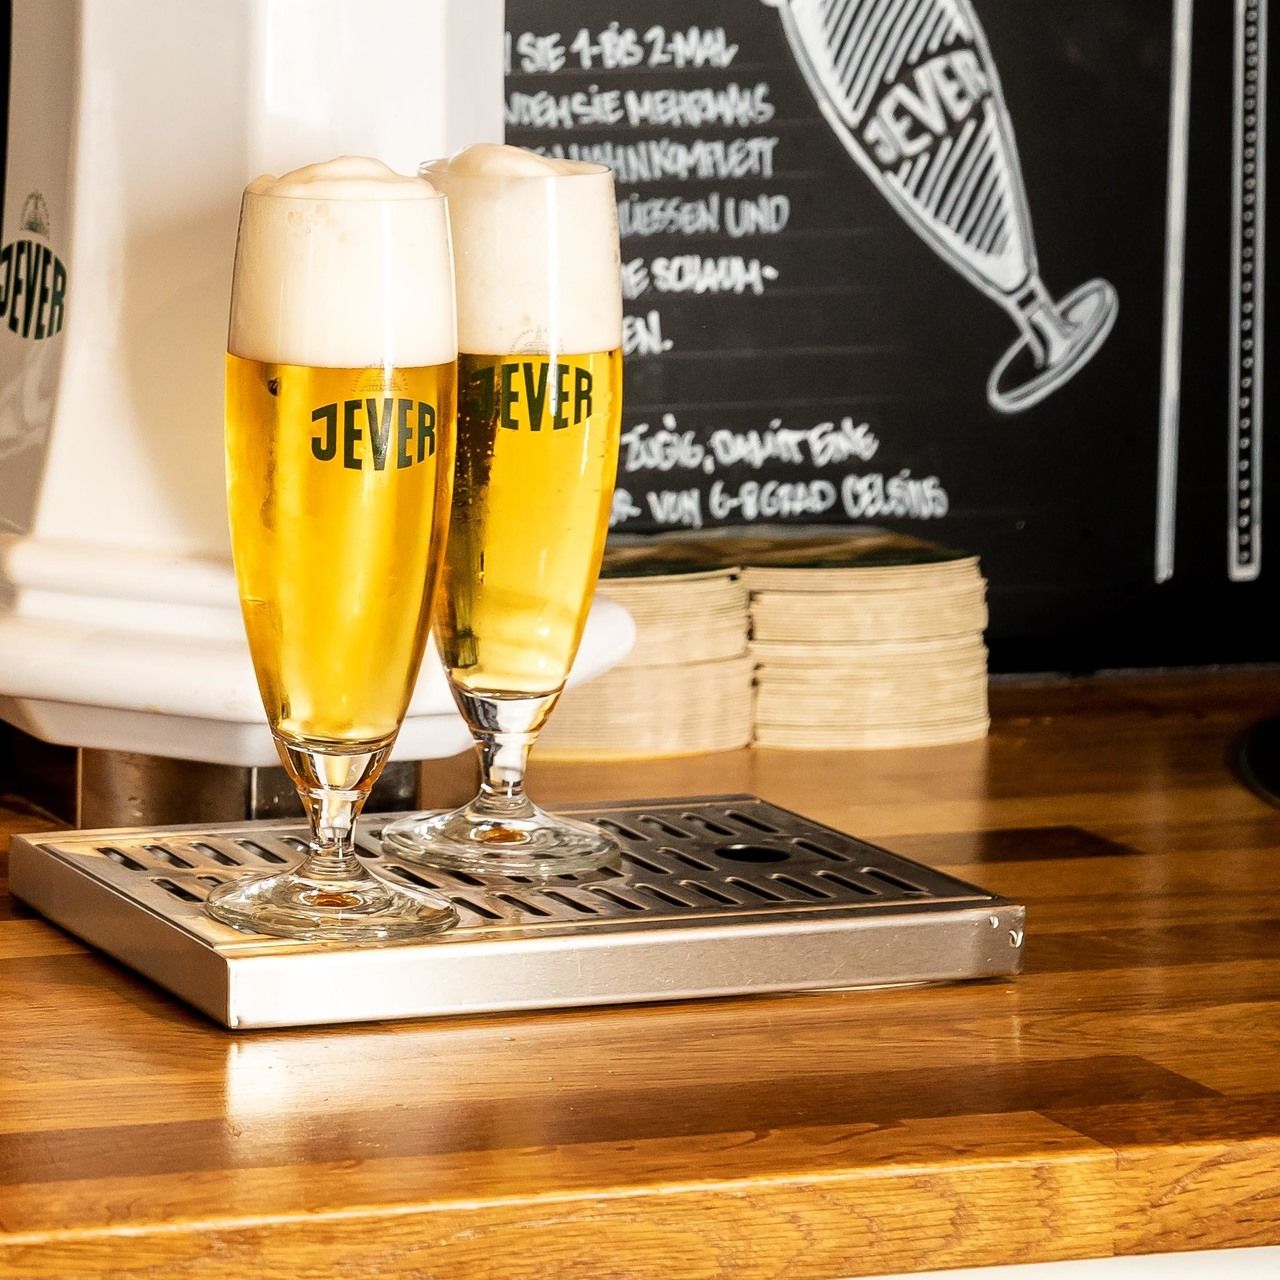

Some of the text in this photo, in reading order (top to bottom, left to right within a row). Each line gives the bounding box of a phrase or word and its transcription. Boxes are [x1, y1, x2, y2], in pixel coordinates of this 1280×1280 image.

[571, 84, 625, 125] SIE
[864, 48, 990, 165] JEVER
[725, 193, 790, 238] UND
[623, 309, 674, 356] EN.
[470, 362, 592, 432] JEVER
[312, 398, 436, 471] JEVER
[841, 468, 949, 519] CELSIUS
